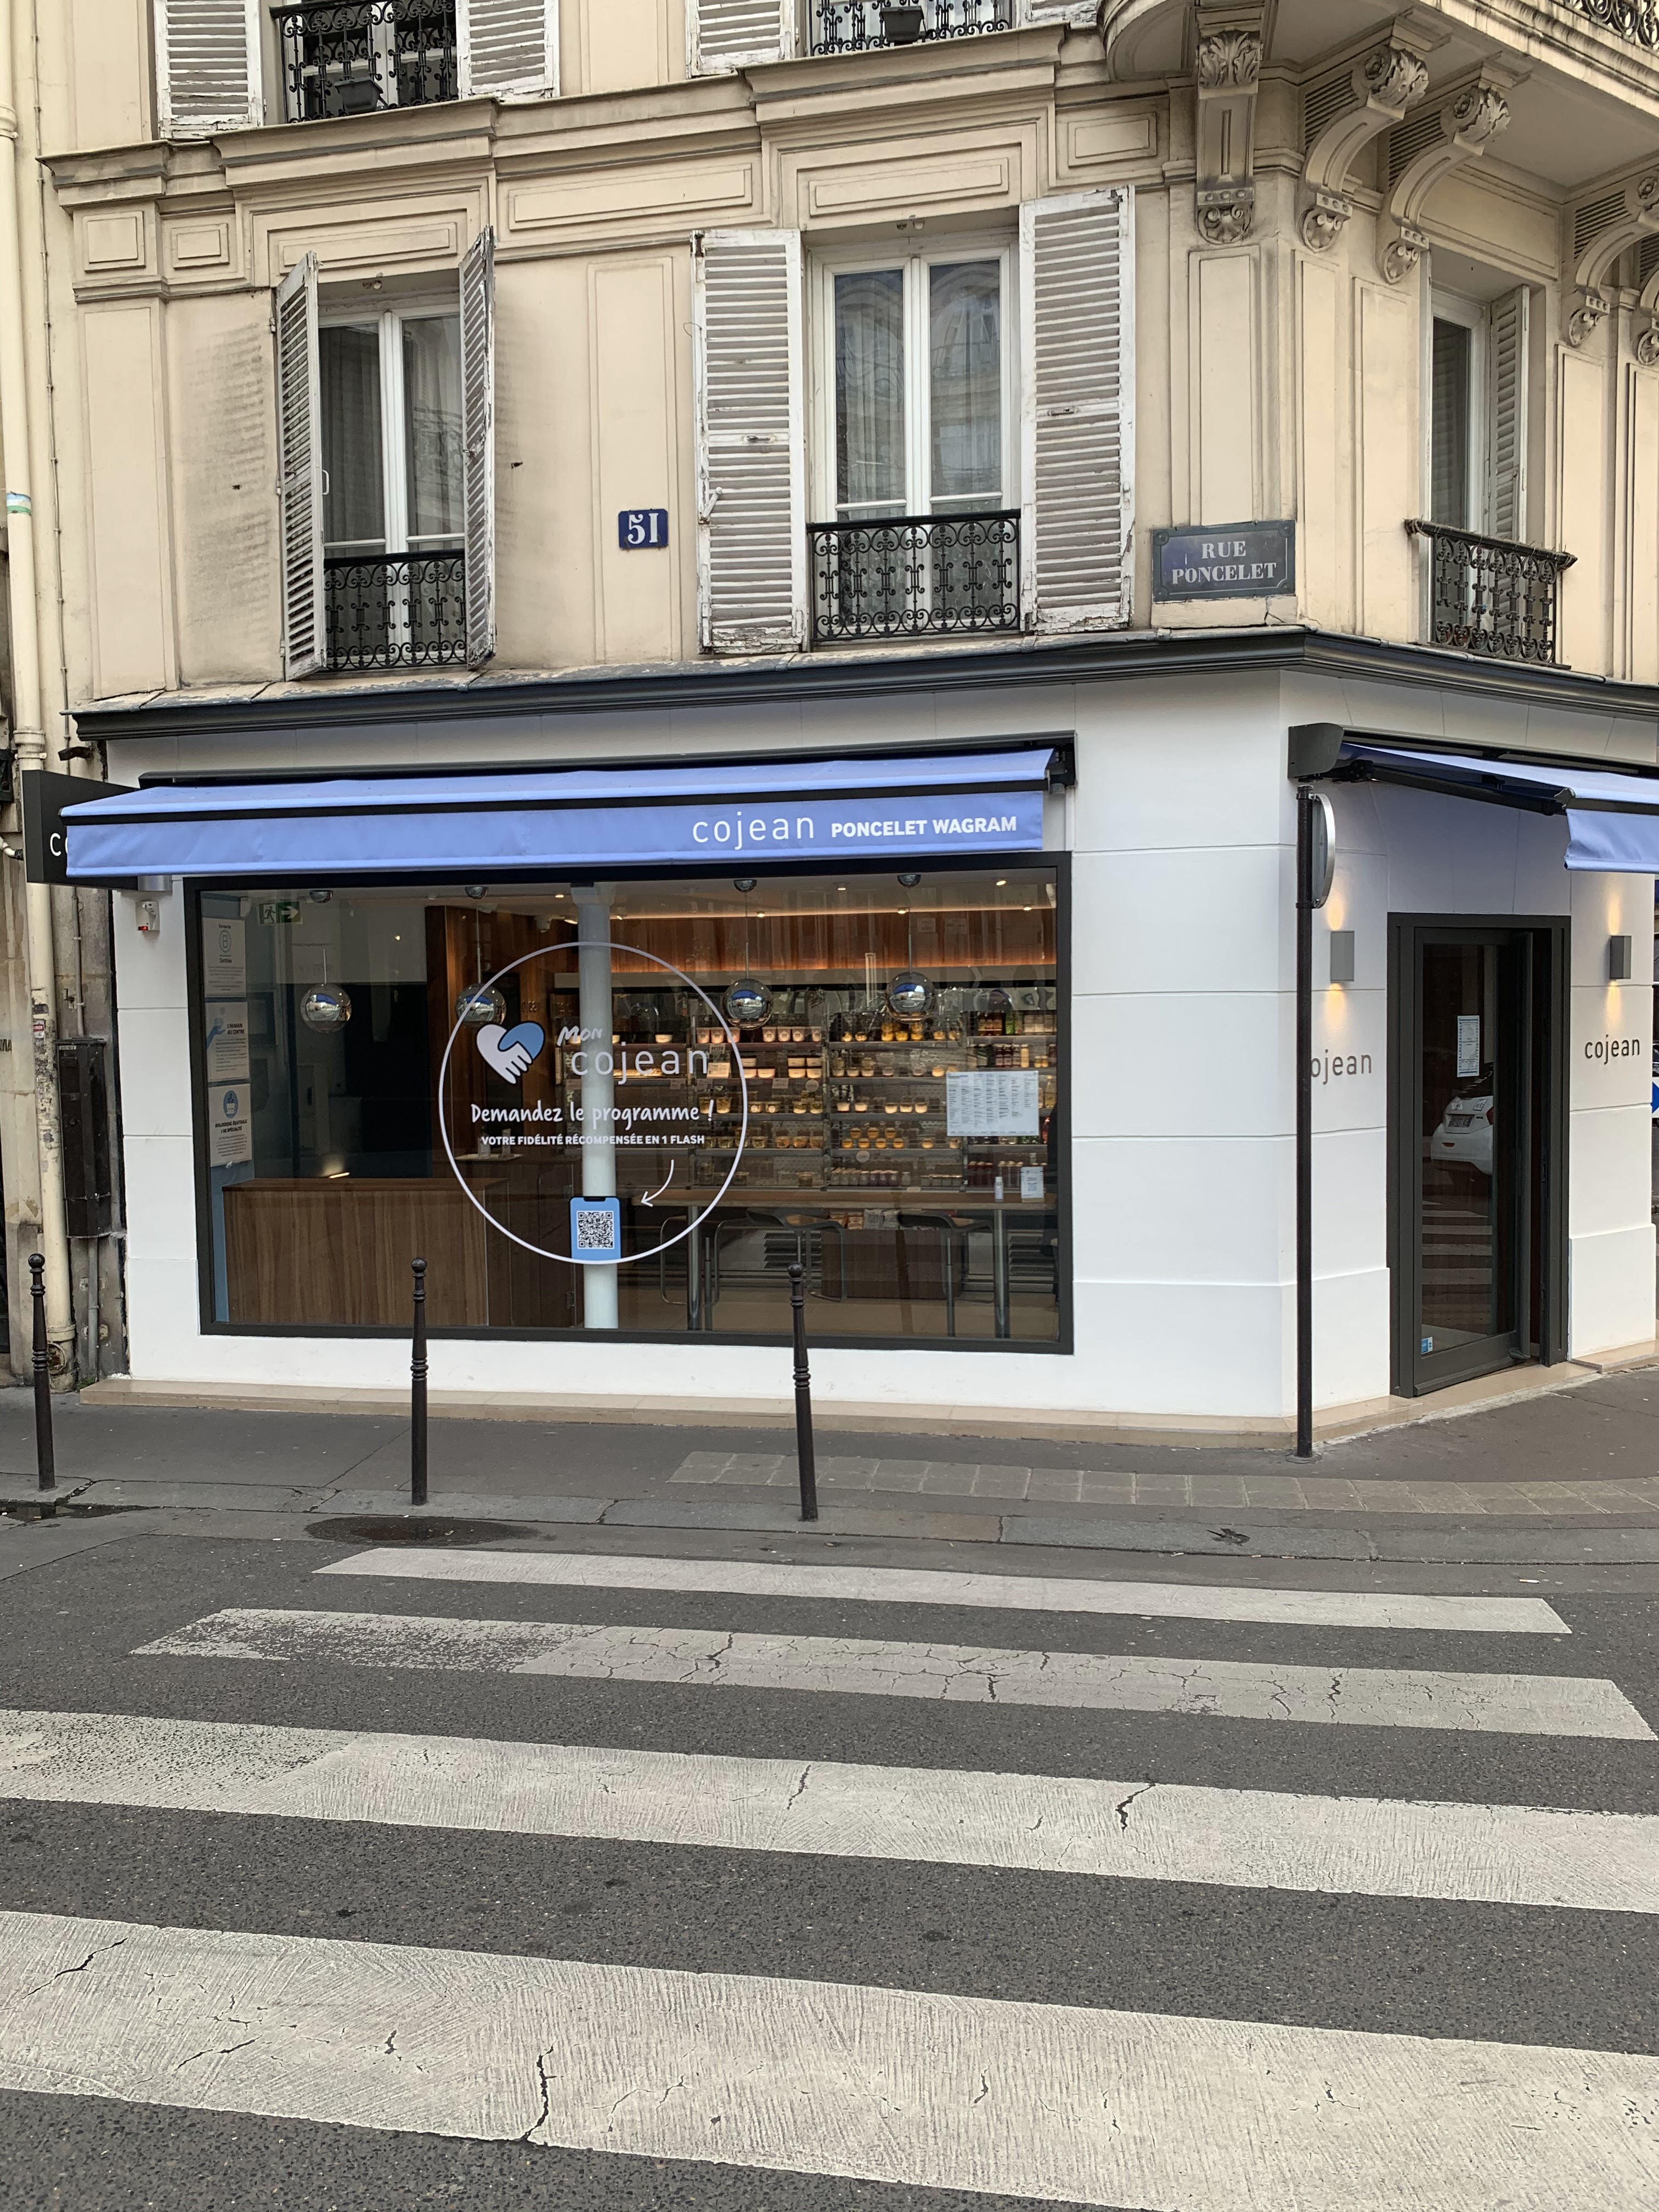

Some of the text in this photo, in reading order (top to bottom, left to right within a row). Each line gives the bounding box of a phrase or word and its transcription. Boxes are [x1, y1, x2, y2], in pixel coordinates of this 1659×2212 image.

[628, 513, 659, 544] 51
[1201, 540, 1246, 559] RUE
[1172, 562, 1277, 584] PONCELET
[693, 811, 1016, 850] cojean PONCELET WAGRAM
[571, 1042, 707, 1085] cojean
[1585, 1034, 1640, 1064] cojean
[1311, 1049, 1372, 1085] ojean
[471, 1099, 563, 1122] Demandez
[570, 1101, 585, 1122] le
[592, 1106, 699, 1131] programme
[481, 1133, 705, 1145] VOTRE FIDÉLITÉ RÉCOMPENSÉE EN 1 FLASH
